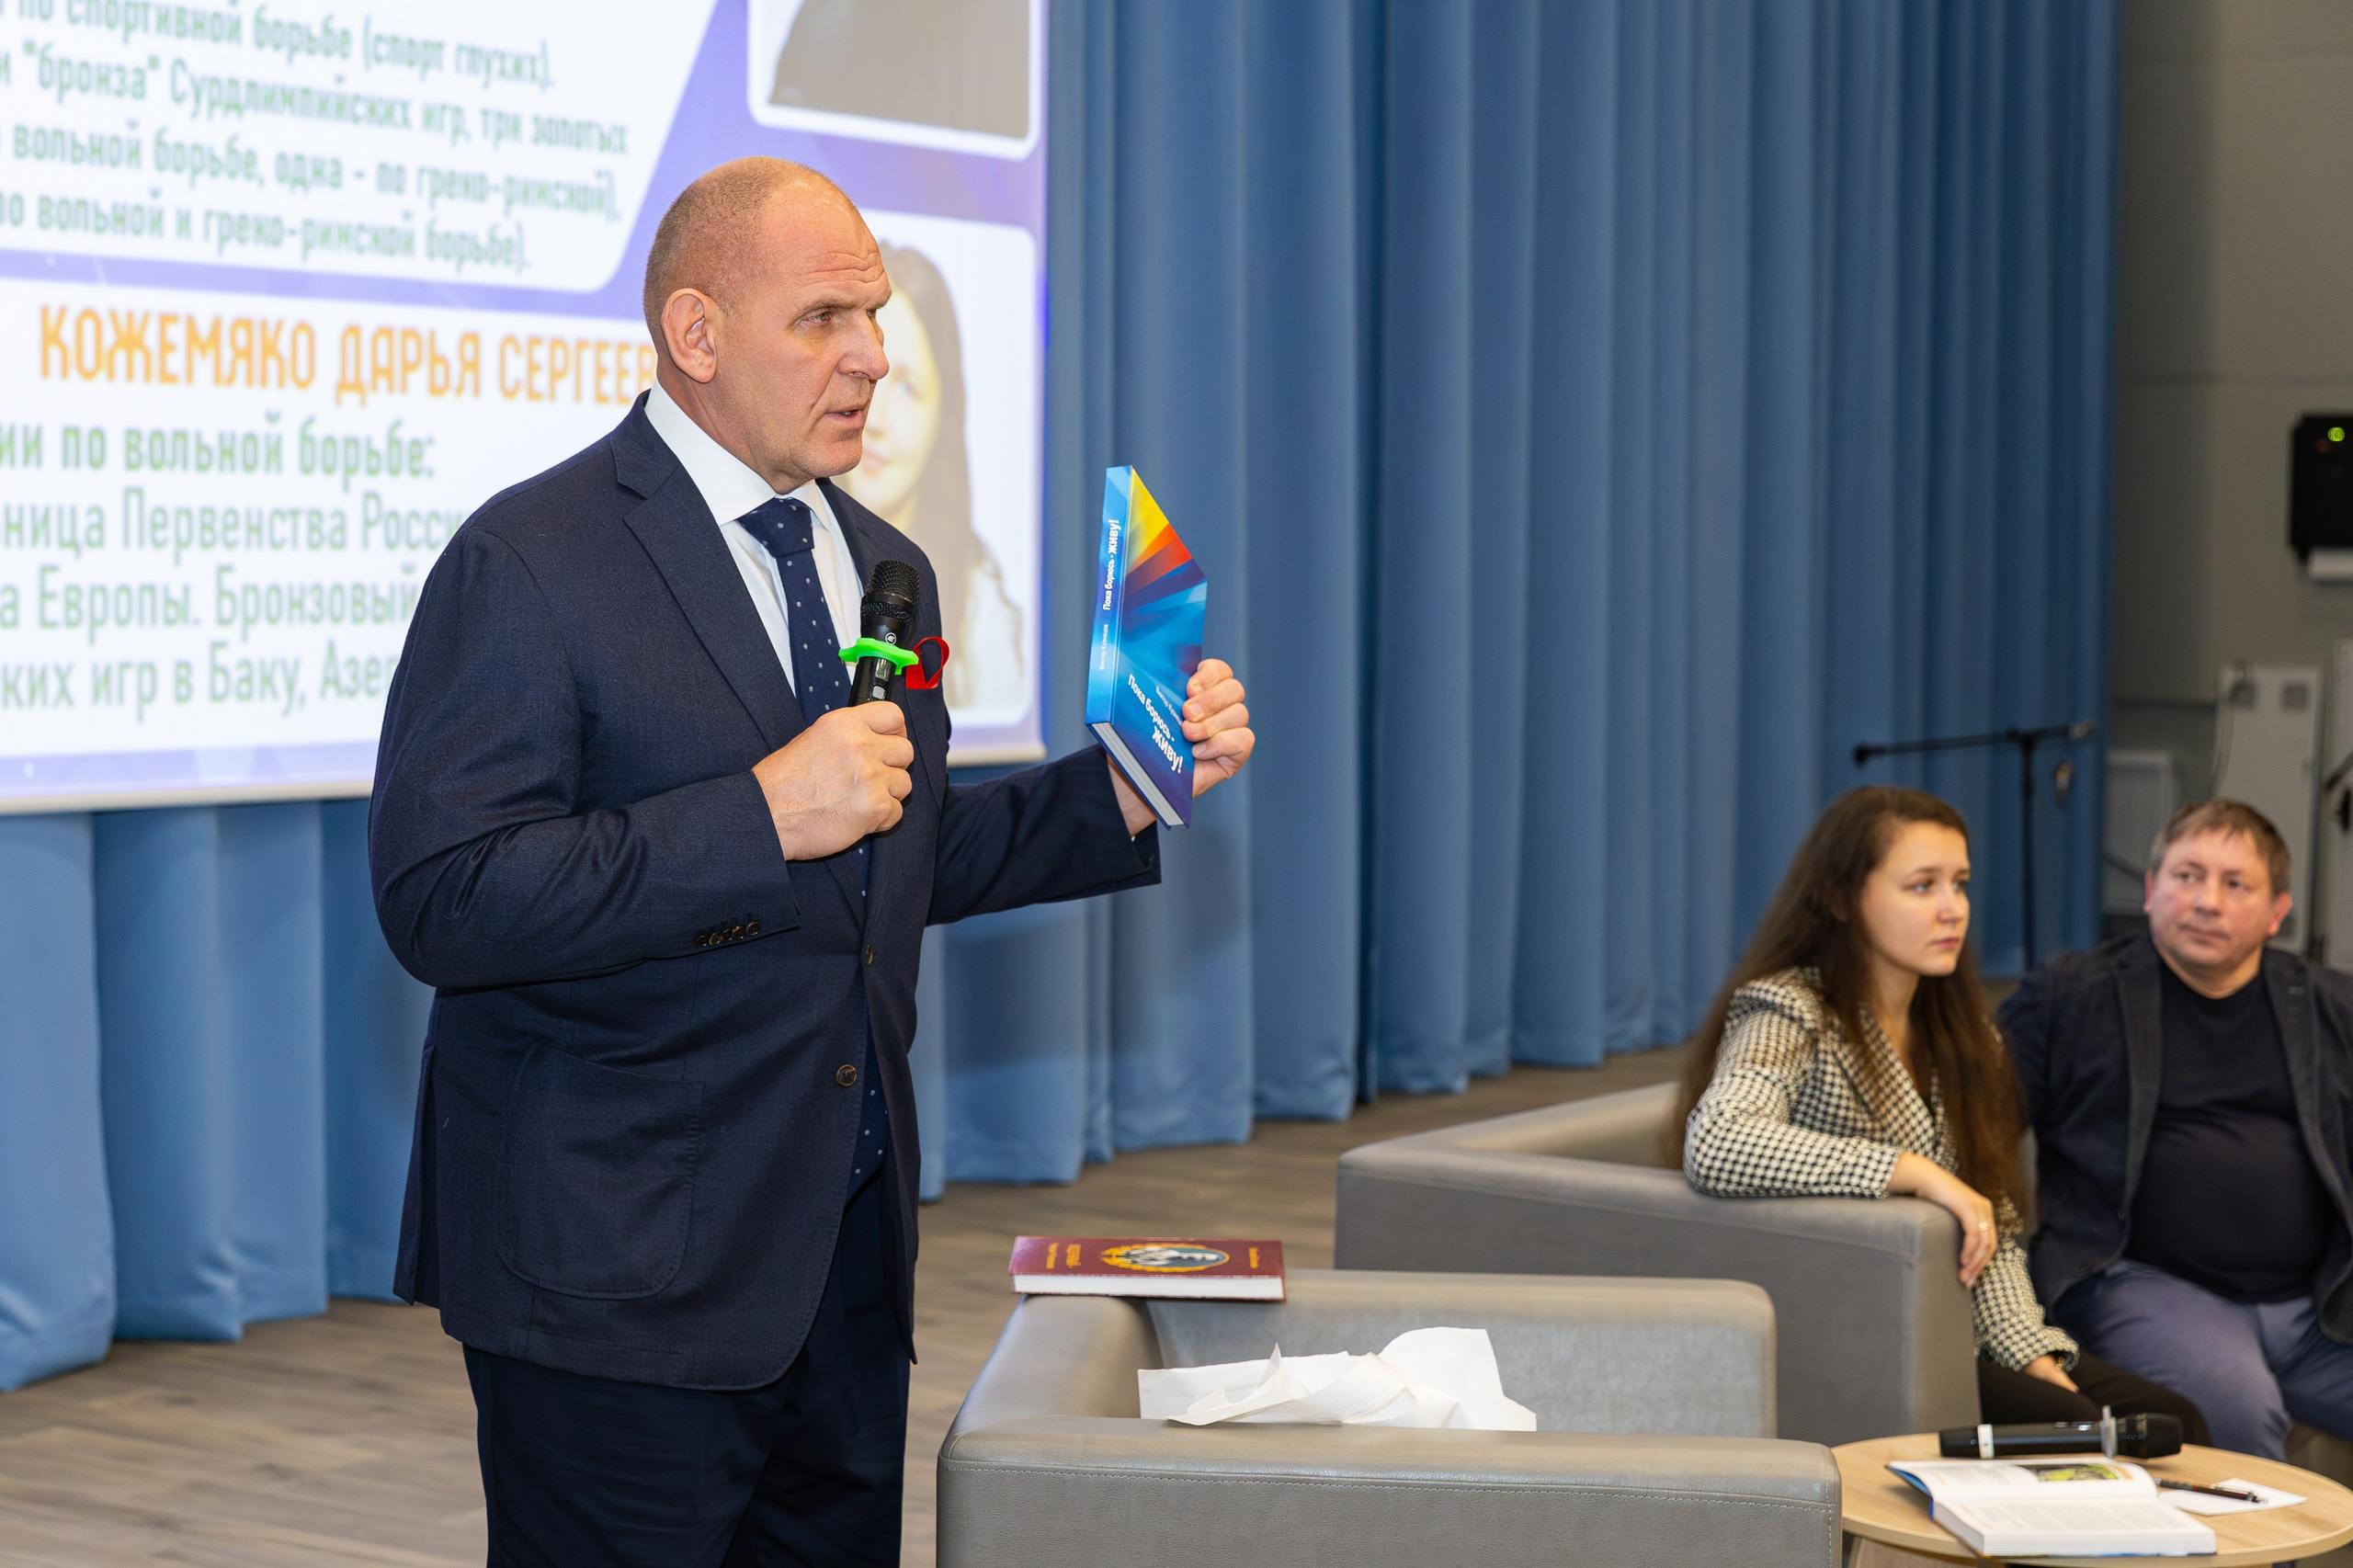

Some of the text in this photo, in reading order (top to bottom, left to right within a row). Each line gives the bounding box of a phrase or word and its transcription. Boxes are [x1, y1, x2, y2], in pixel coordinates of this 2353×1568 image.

[67, 0, 242, 45] спортивной
[254, 4, 352, 64] борьбе
[363, 14, 445, 84] (спорт
[23, 39, 159, 105] "бронза"
[170, 57, 413, 131] Сурдлимпийских
[421, 101, 472, 147] игр,
[481, 107, 522, 152] три
[14, 118, 142, 170] вольной
[153, 126, 266, 188] борьбе,
[275, 151, 343, 193] одна
[376, 161, 407, 196] по
[0, 186, 530, 277] о вольной и греко-римской борьбе).
[40, 304, 316, 391] КОЖЕМЯКО
[335, 324, 481, 408] ДАРЬЯ
[62, 425, 106, 471] по
[124, 410, 283, 475] вольной
[299, 415, 434, 494] борьбе:
[4, 504, 105, 560] ница
[122, 485, 347, 568] Первенства
[39, 562, 200, 645] Европы.
[214, 562, 419, 642] Бронзовый
[1103, 590, 1112, 610] Пока
[1104, 559, 1115, 589] борюсь
[92, 661, 158, 724] игр
[174, 658, 193, 704] в
[208, 640, 306, 727] Баку,
[1128, 673, 1146, 705] Пока
[1145, 698, 1172, 740] борюсь
